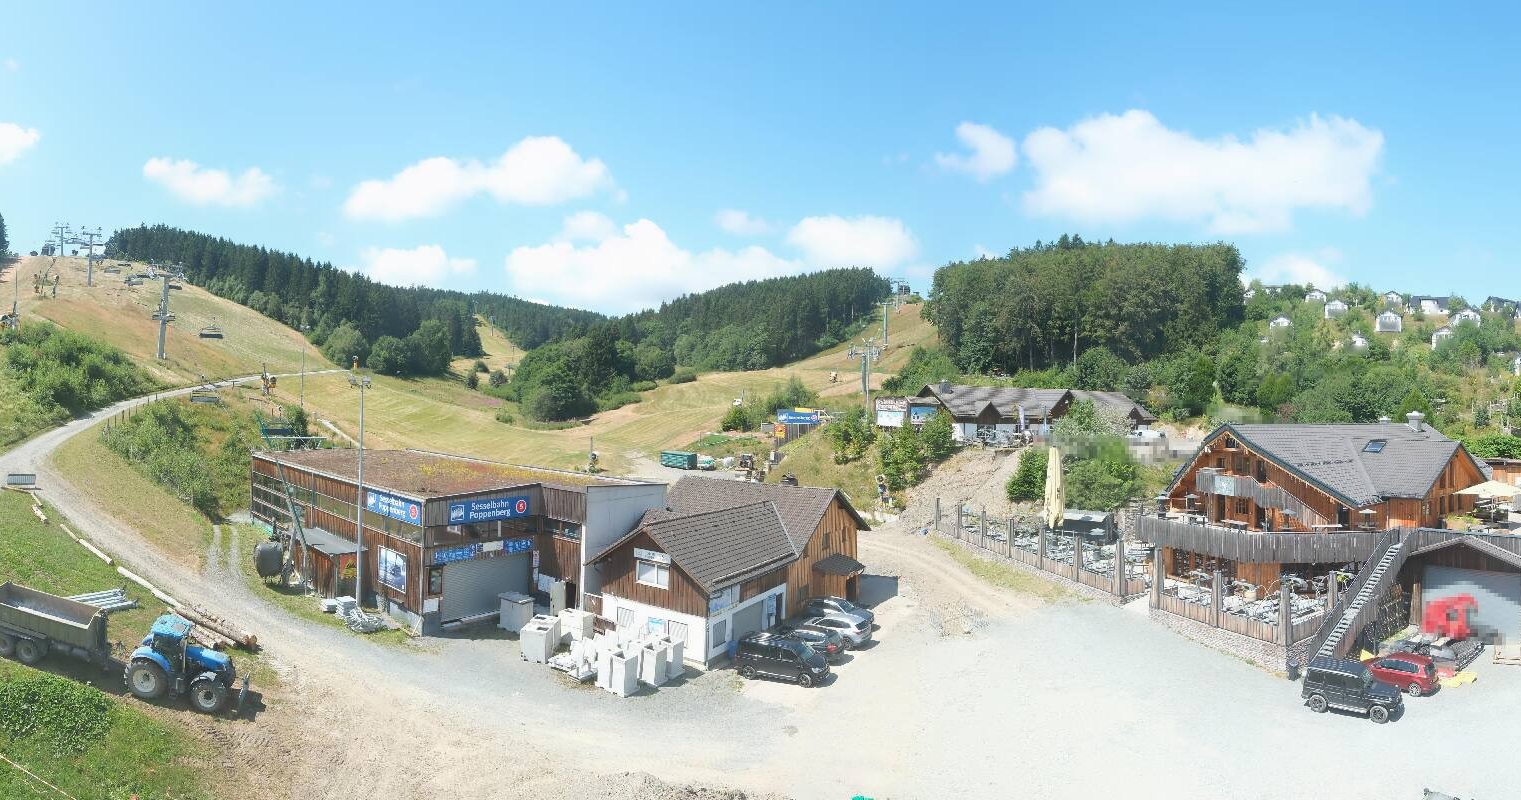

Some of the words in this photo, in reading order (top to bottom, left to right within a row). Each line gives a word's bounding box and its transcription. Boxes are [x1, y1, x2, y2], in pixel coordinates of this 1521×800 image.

[379, 494, 405, 508] Sesselbahn
[471, 500, 509, 511] Sesselbahn
[378, 501, 405, 518] Poppenberg
[469, 509, 511, 519] Poppenberg
